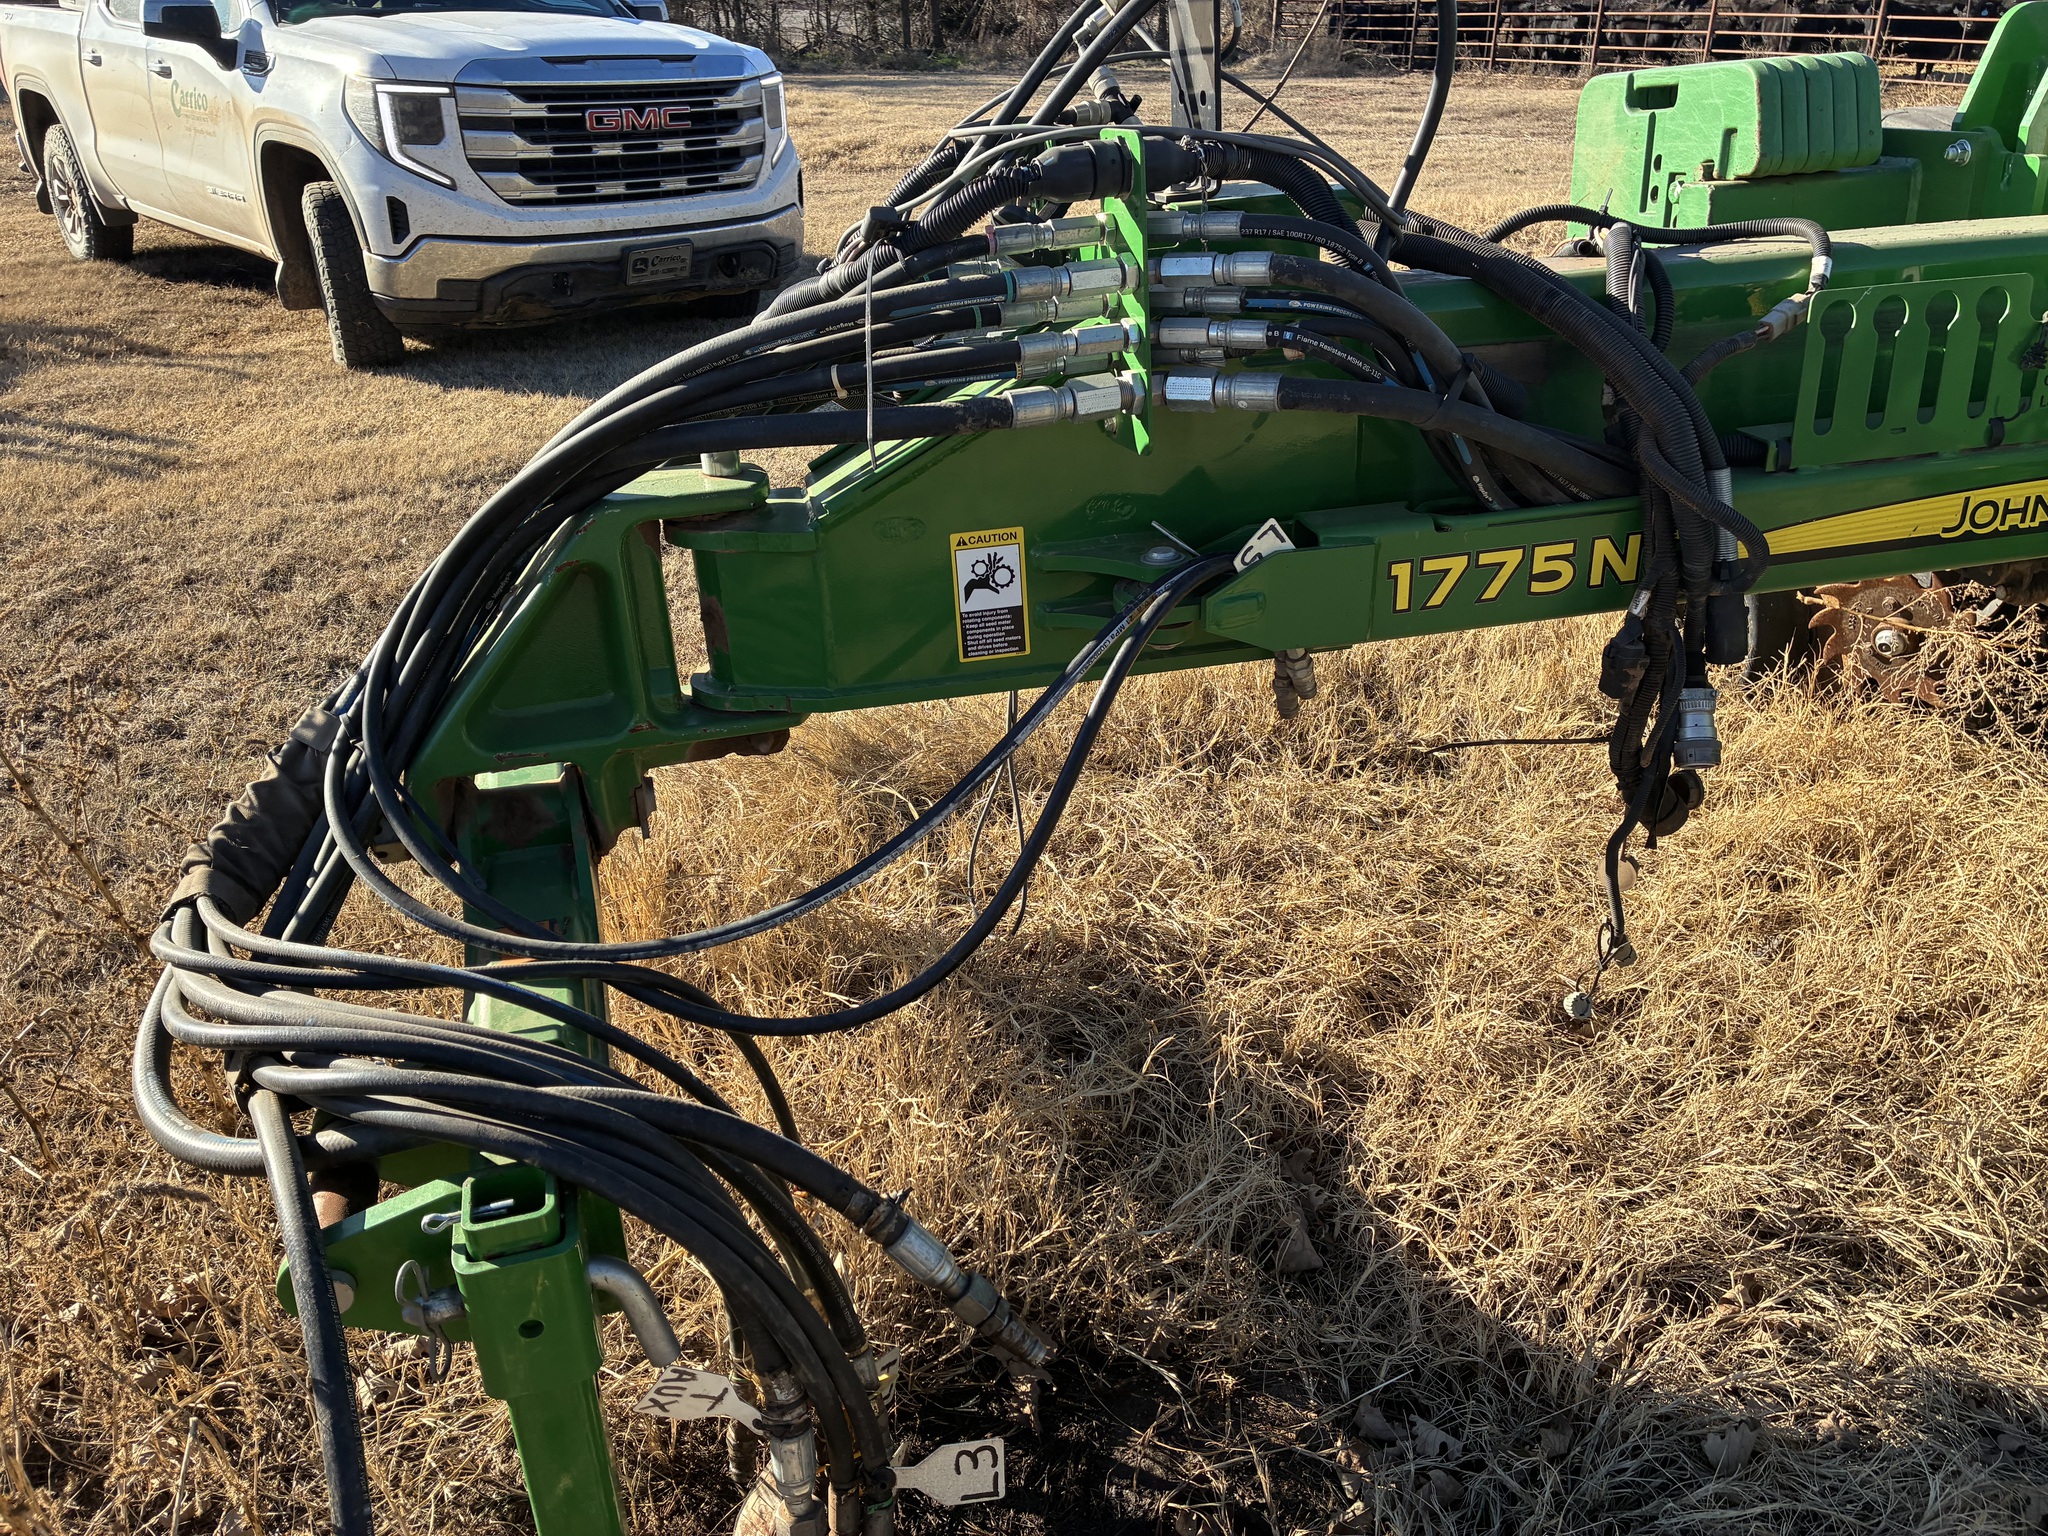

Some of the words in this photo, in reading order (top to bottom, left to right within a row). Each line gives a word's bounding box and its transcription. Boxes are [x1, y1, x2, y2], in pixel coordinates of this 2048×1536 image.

[171, 80, 208, 117] Carrico
[585, 106, 692, 132] GMC
[1272, 229, 1285, 237] SAE
[1314, 235, 1325, 245] ISO
[1326, 239, 1346, 254] 18752
[1346, 249, 1360, 263] Type
[651, 254, 681, 267] Carrico
[1303, 302, 1333, 312] POWERING
[1296, 334, 1319, 347] Flame
[1319, 341, 1347, 361] Resistant
[1347, 354, 1363, 368] MSHA
[1362, 362, 1382, 379] 2G-11C
[937, 377, 965, 386] POWERING
[968, 531, 1018, 546] CAUTION
[1387, 538, 1578, 614] 1775
[966, 627, 995, 635] components
[1110, 624, 1126, 640] MPa
[823, 888, 842, 901] MPa
[843, 882, 854, 891] 21
[343, 1365, 352, 1381] SAE
[647, 1368, 696, 1413] AUX
[954, 1444, 1000, 1501] L3
